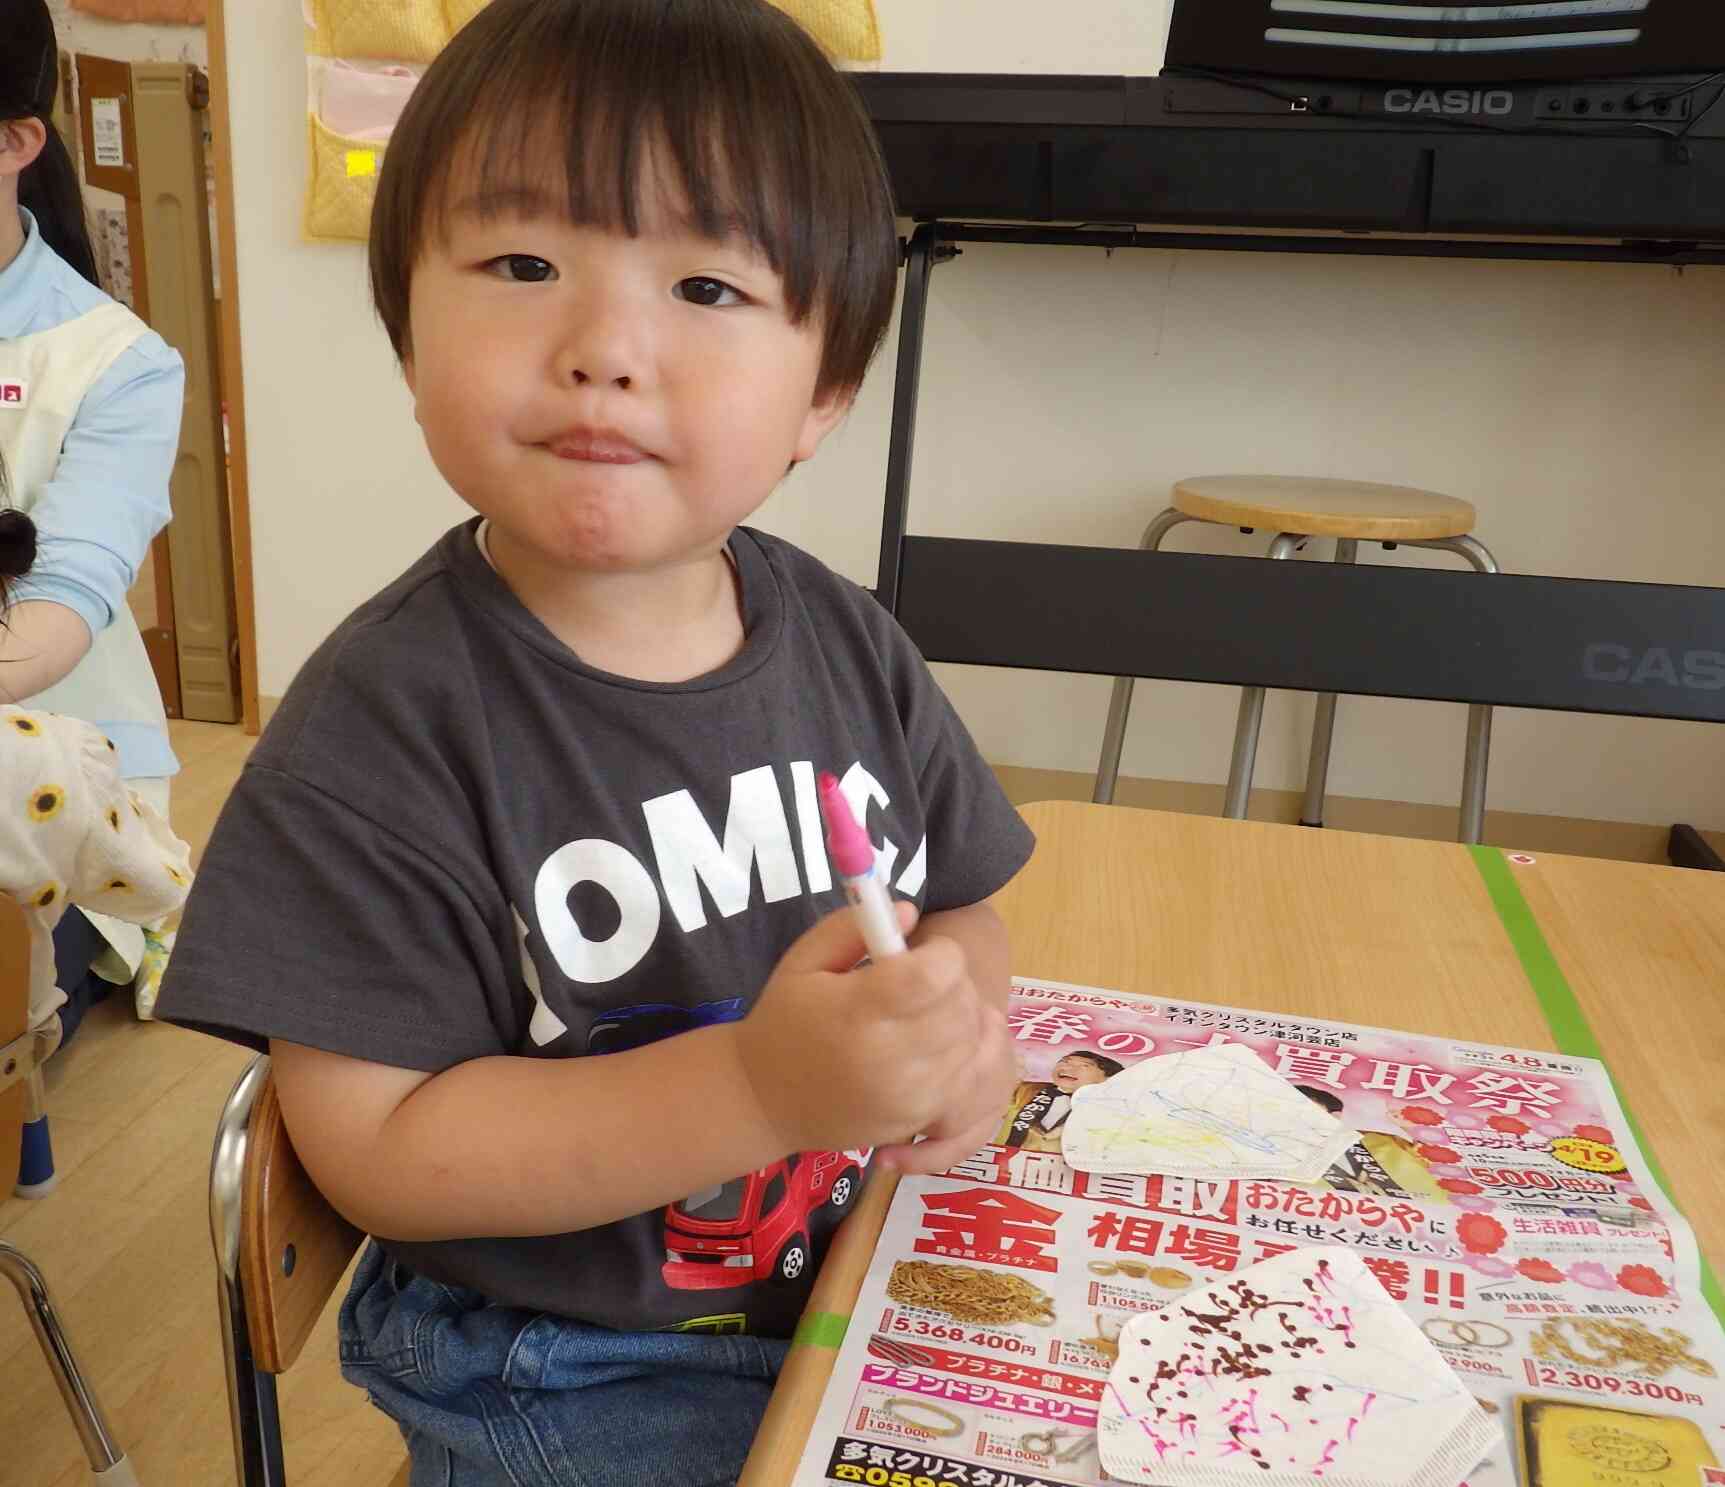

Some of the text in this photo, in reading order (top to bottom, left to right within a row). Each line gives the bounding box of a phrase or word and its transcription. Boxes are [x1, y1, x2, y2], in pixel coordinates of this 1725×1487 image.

[1383, 89, 1514, 116] CASIO
[510, 760, 927, 1047] OMIC
[1167, 1006, 1359, 1041] 多気クリスタルタウン店
[1006, 1006, 1562, 1118] 春の買取祭
[913, 1187, 1063, 1273] 金
[1513, 1217, 1602, 1236] 生活雑貨
